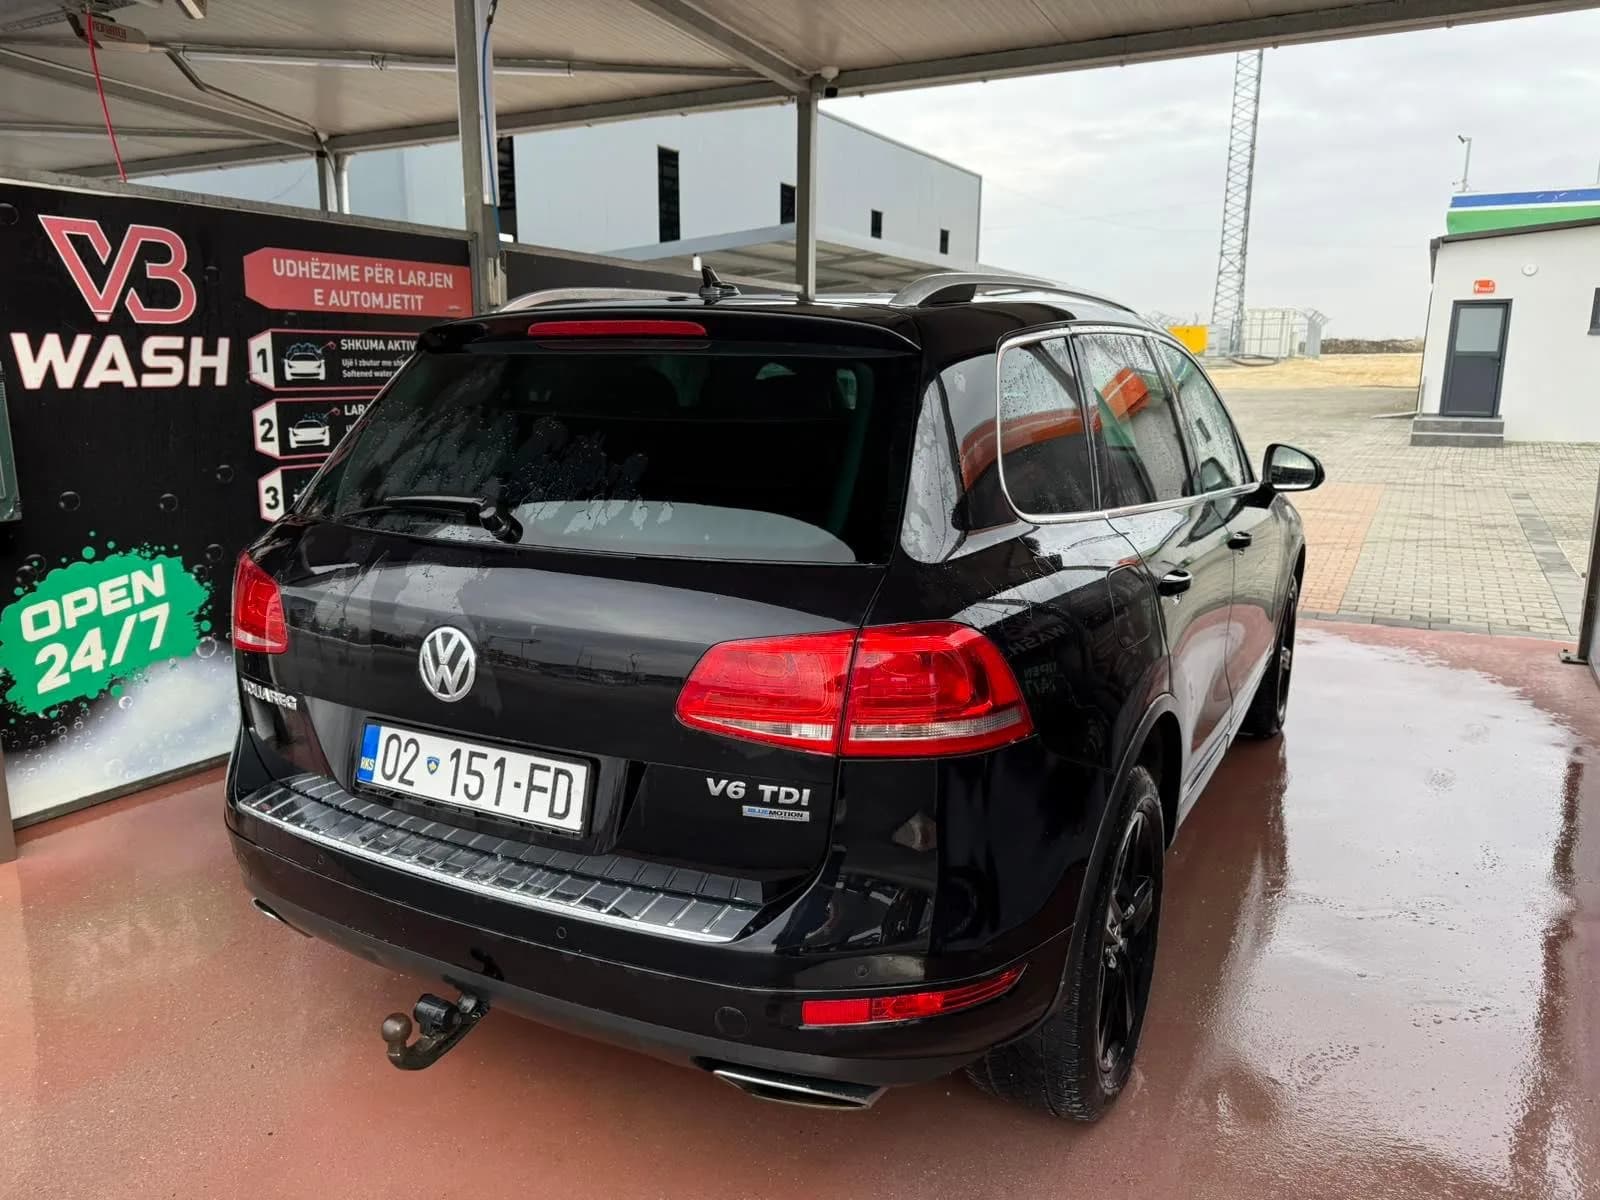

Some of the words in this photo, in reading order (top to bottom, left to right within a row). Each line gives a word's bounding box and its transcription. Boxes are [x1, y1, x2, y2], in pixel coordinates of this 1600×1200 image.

[272, 257, 360, 282] UDHËZIME
[364, 263, 394, 285] PËR
[398, 269, 454, 289] LARJEN
[313, 288, 325, 306] E
[328, 290, 424, 311] AUTOMJETIT
[341, 338, 385, 351] SHKUMA
[387, 340, 417, 352] AKTIV
[10, 332, 230, 390] WASH
[256, 348, 269, 373] 1
[342, 369, 373, 378] Softened
[373, 370, 393, 378] water
[259, 418, 275, 443] 2
[265, 486, 280, 510] 3
[20, 563, 167, 642] OPEN
[34, 602, 170, 695] 24/7
[381, 732, 420, 788] 02
[706, 777, 746, 799] V6
[758, 783, 811, 806] TDI
[747, 807, 804, 818] BLUEMOTION
